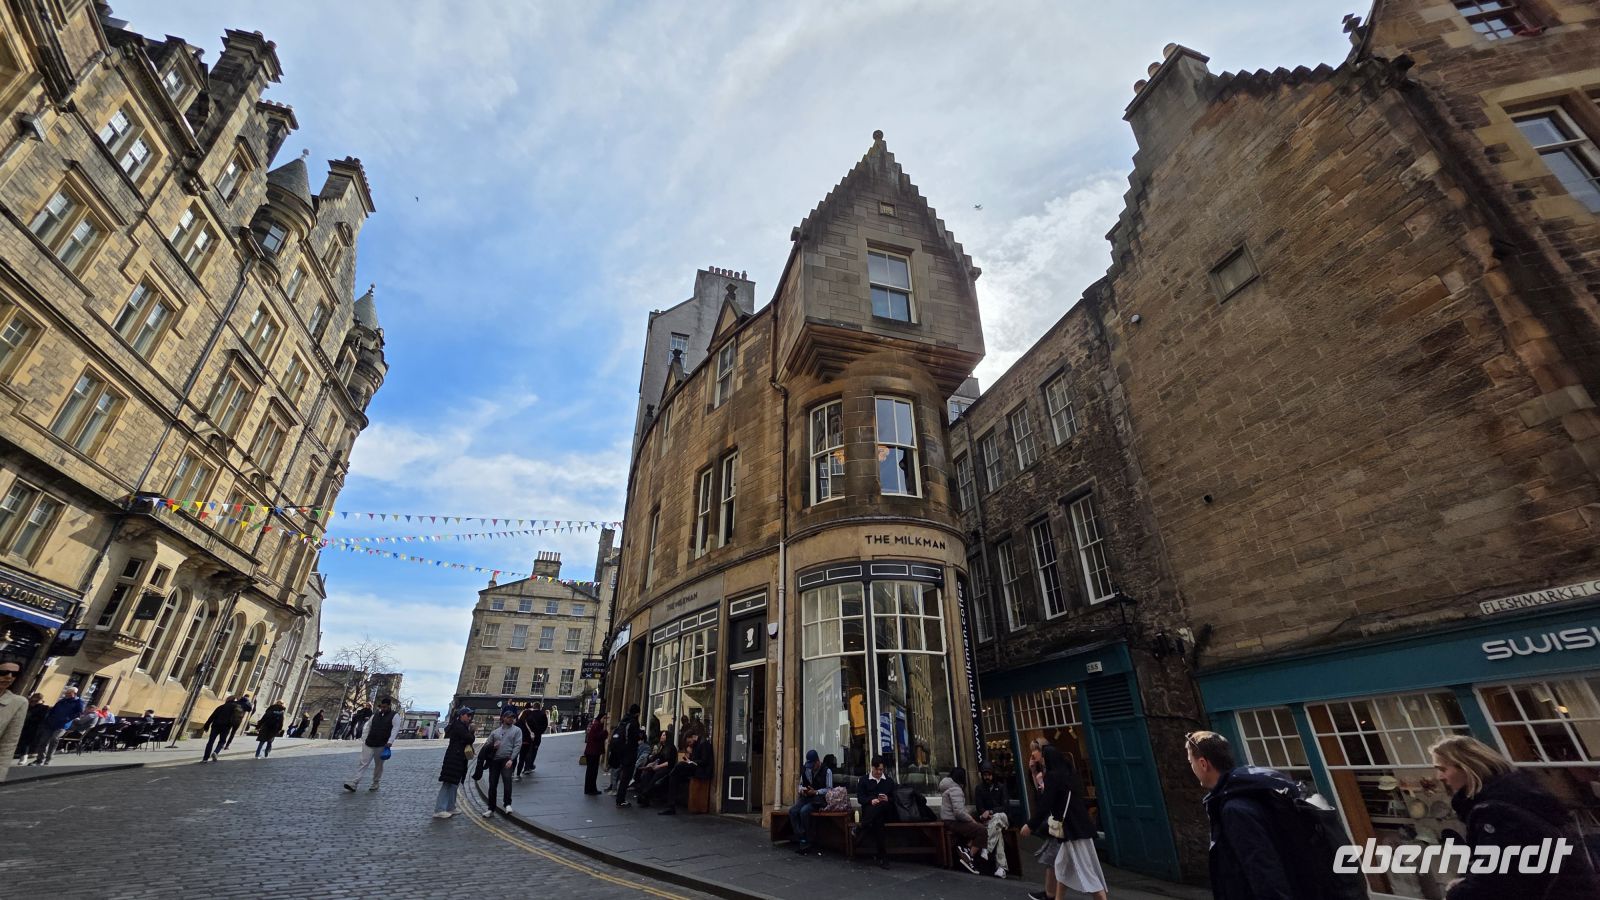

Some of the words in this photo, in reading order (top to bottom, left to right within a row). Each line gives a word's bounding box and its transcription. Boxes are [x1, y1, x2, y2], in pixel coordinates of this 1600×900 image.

[865, 534, 890, 545] THE
[894, 535, 946, 550] MILKMAN
[11, 587, 57, 611] LOUNGE
[1482, 584, 1589, 614] FLESHMARKET
[1481, 626, 1600, 661] SWIS
